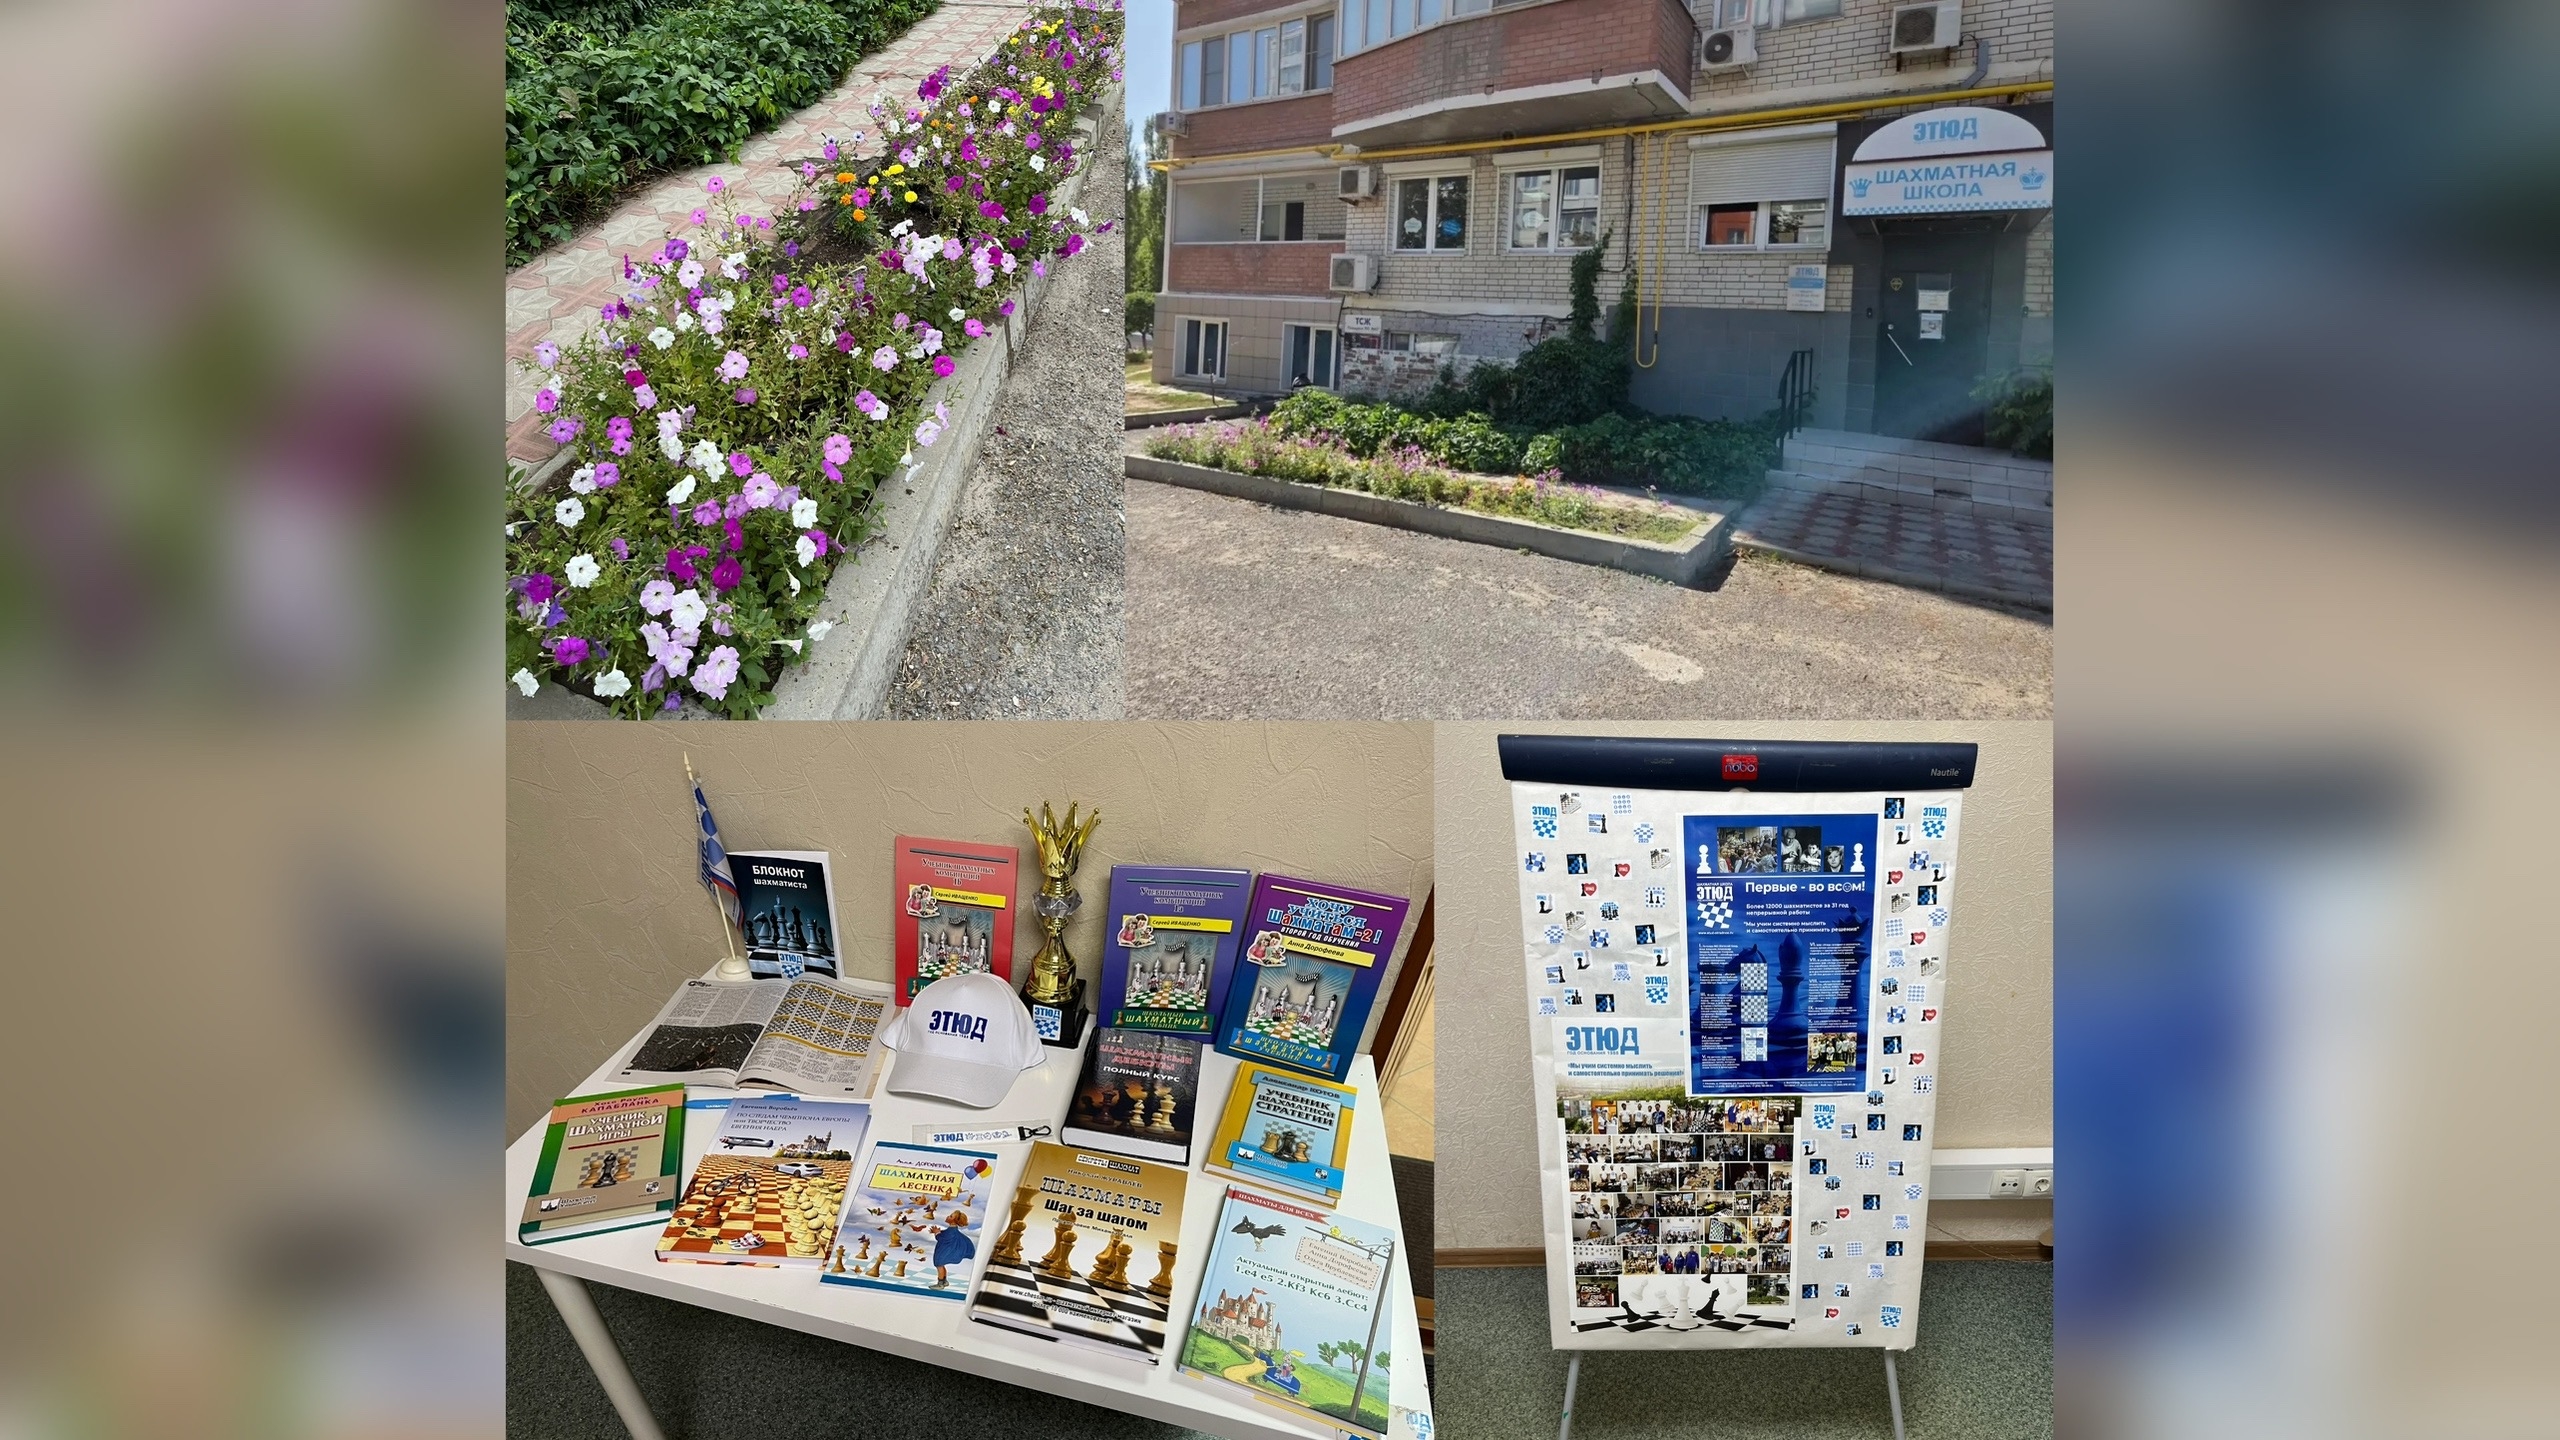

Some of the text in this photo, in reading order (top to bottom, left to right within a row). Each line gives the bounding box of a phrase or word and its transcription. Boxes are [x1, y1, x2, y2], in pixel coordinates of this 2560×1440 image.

[1913, 118, 1977, 141] ЭТЮД
[1876, 162, 2016, 184] ШАХМАТНАЯ
[1904, 182, 1983, 200] ШКОЛА
[1355, 317, 1371, 325] ТСЖ
[1725, 761, 1756, 772] nobo
[1930, 768, 1960, 777] Nautile
[1532, 806, 1557, 817] ЭТЮД
[1923, 807, 1947, 817] ЭТЮД
[752, 865, 804, 879] БЛОКНОТ
[754, 878, 807, 890] шахматиста
[1745, 882, 1797, 895] Первые
[1809, 883, 1824, 892] во
[1697, 887, 1733, 900] ЭТЮД
[1280, 927, 1360, 948] ВТОРОЙ ГОД ОБУЧЕНИЯ
[1287, 940, 1345, 957] Анна Дорофеева
[779, 952, 803, 965] ЭТЮД
[1645, 976, 1668, 985] ЭТЮД
[1035, 1007, 1060, 1019] ЭТЮД
[929, 1010, 988, 1043] ЭТЮД
[1125, 1015, 1200, 1026] ШАХМАТНЫЙ
[1566, 1027, 1639, 1055] ЭТЮД
[1103, 1066, 1180, 1082] ПОЛНЫЙ КУРС
[1265, 1088, 1331, 1110] УЧЕБНИК
[1310, 1087, 1340, 1099] КОТОВ
[581, 1098, 659, 1114] КАПАБЛАНКА
[620, 1096, 649, 1104] Рауль
[1258, 1094, 1335, 1118] ШАХМАТНОЙ
[1256, 1101, 1334, 1126] СТРАТЕГИИ
[1814, 1104, 1835, 1113] ЭТЮД
[568, 1113, 663, 1137] ШАХМАТНОЙ
[590, 1112, 646, 1125] УЧЕБНИК
[599, 1130, 632, 1141] ИГРЫ
[933, 1133, 964, 1142] ЭТЮД
[879, 1168, 955, 1184] ШАХМАТНАЯ
[899, 1181, 953, 1194] ЛЕСЕНКА
[1040, 1177, 1163, 1216] ШАХМАТЫ
[1239, 1193, 1315, 1218] ШАХМАТЫ ДЛЯ ВСЕХ
[1044, 1199, 1148, 1231] Шаг за шагом
[1304, 1254, 1324, 1266] Ольга
[1309, 1250, 1327, 1260] Анна
[1234, 1264, 1258, 1278] 1.e4
[1259, 1272, 1274, 1283] e5
[1236, 1255, 1369, 1302] Актуальный открытый дебют:
[1882, 1306, 1901, 1315] ЭТЮД
